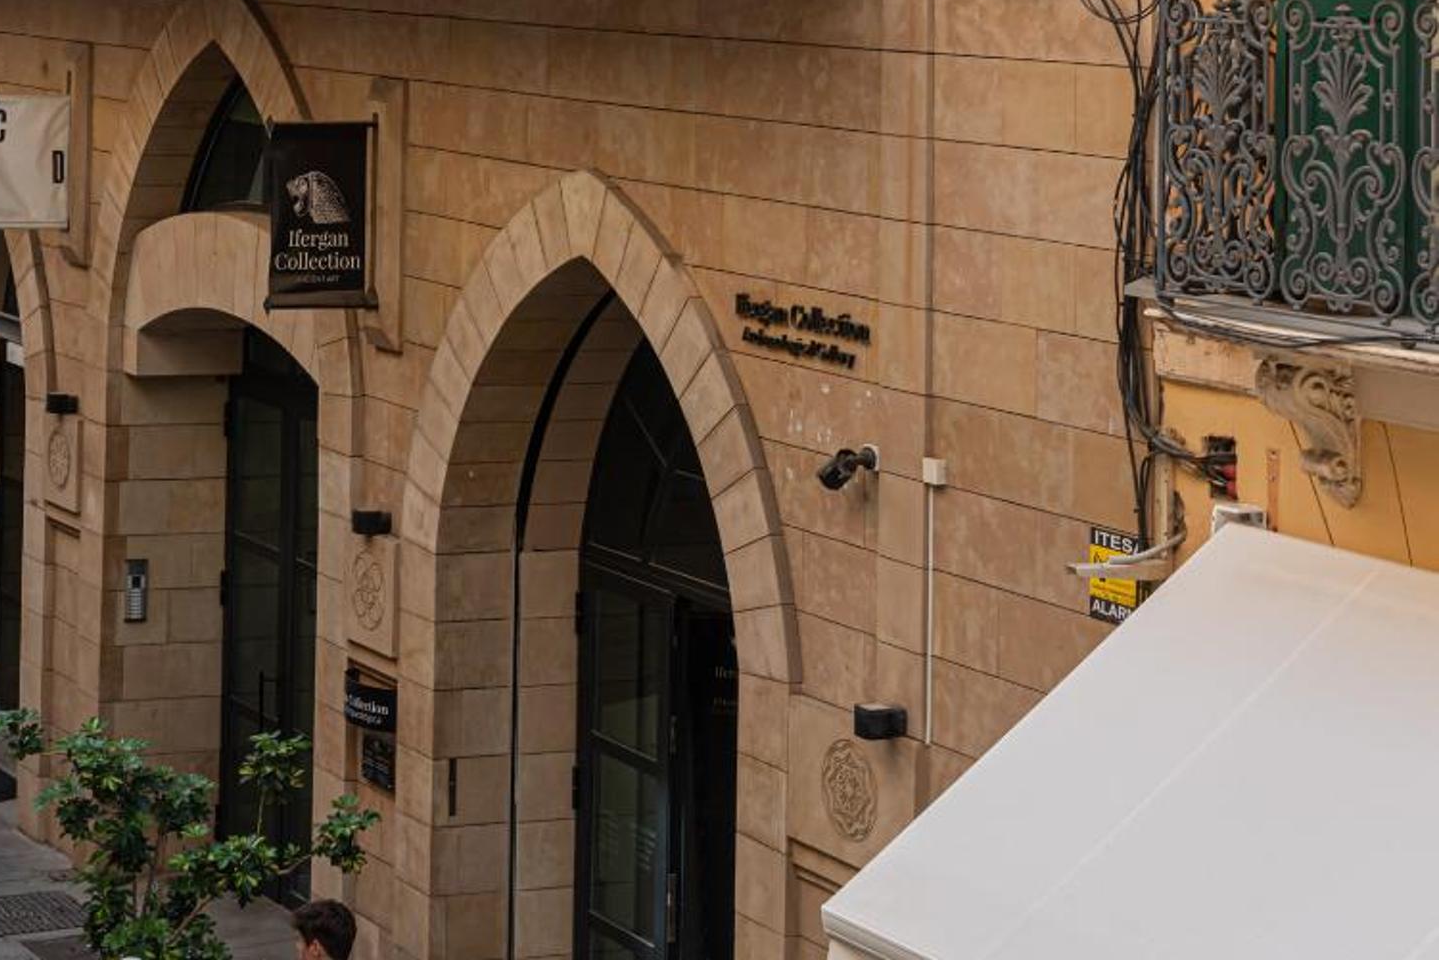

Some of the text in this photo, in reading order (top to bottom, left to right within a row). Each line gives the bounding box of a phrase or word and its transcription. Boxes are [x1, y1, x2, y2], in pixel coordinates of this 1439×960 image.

[52, 150, 64, 184] D
[288, 228, 349, 250] Ifergan
[274, 251, 360, 271] Collection
